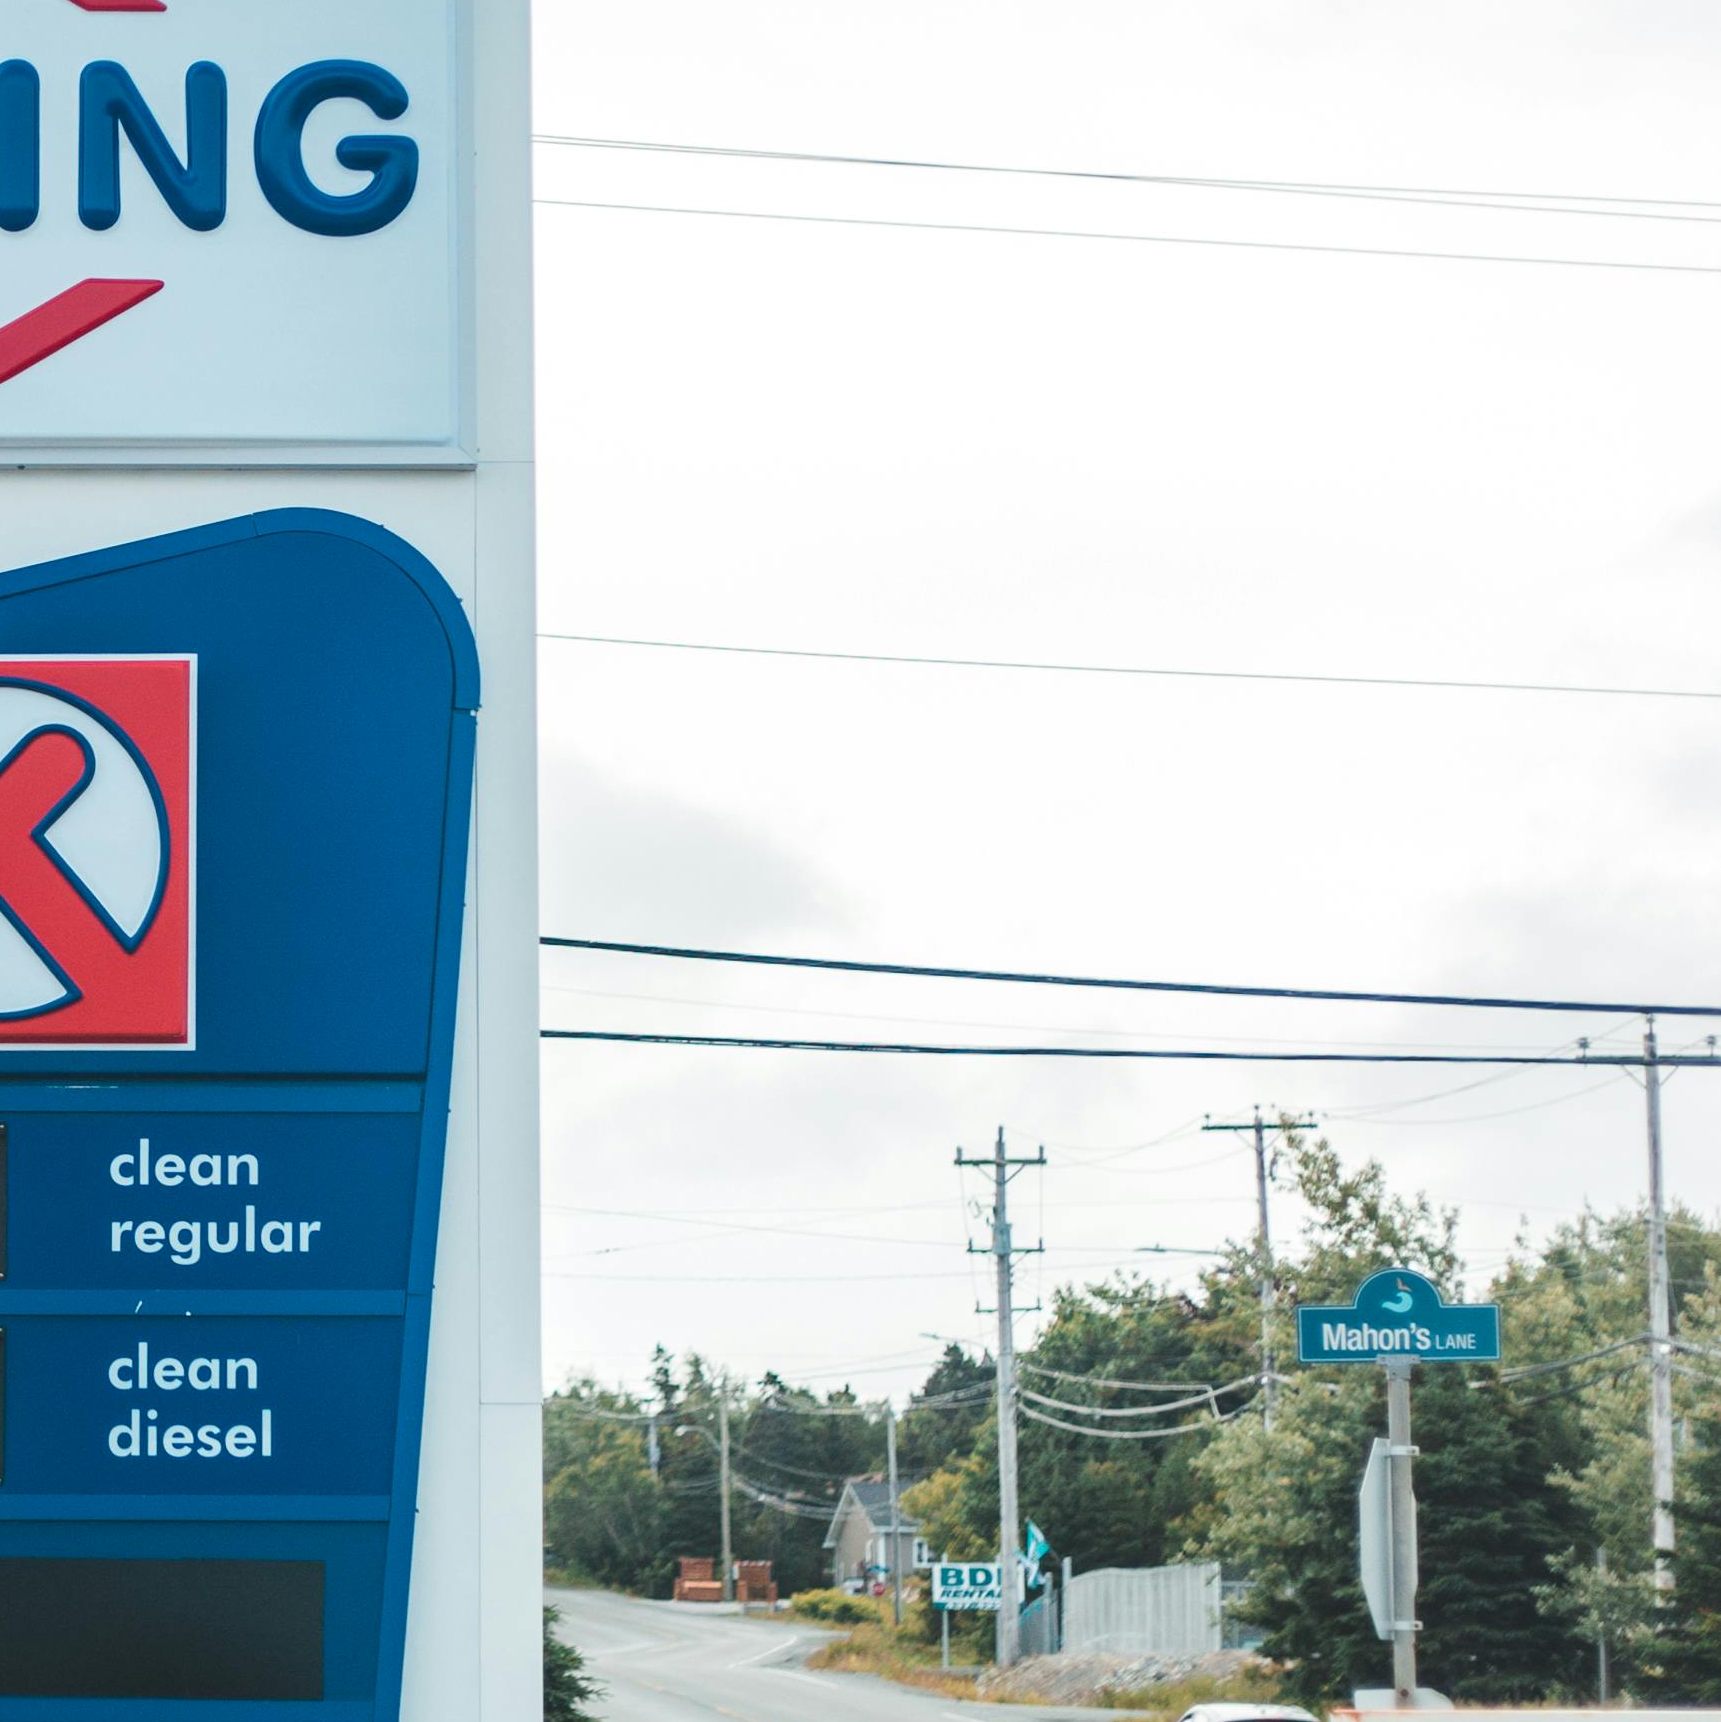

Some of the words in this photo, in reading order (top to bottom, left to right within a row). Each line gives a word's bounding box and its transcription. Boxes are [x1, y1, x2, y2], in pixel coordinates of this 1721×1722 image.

[109, 1138, 259, 1186] clean
[111, 1205, 321, 1265] regular
[1322, 1323, 1431, 1351] Mahon's
[1435, 1334, 1477, 1350] LANE
[108, 1342, 258, 1390] clean
[108, 1409, 272, 1457] diesel
